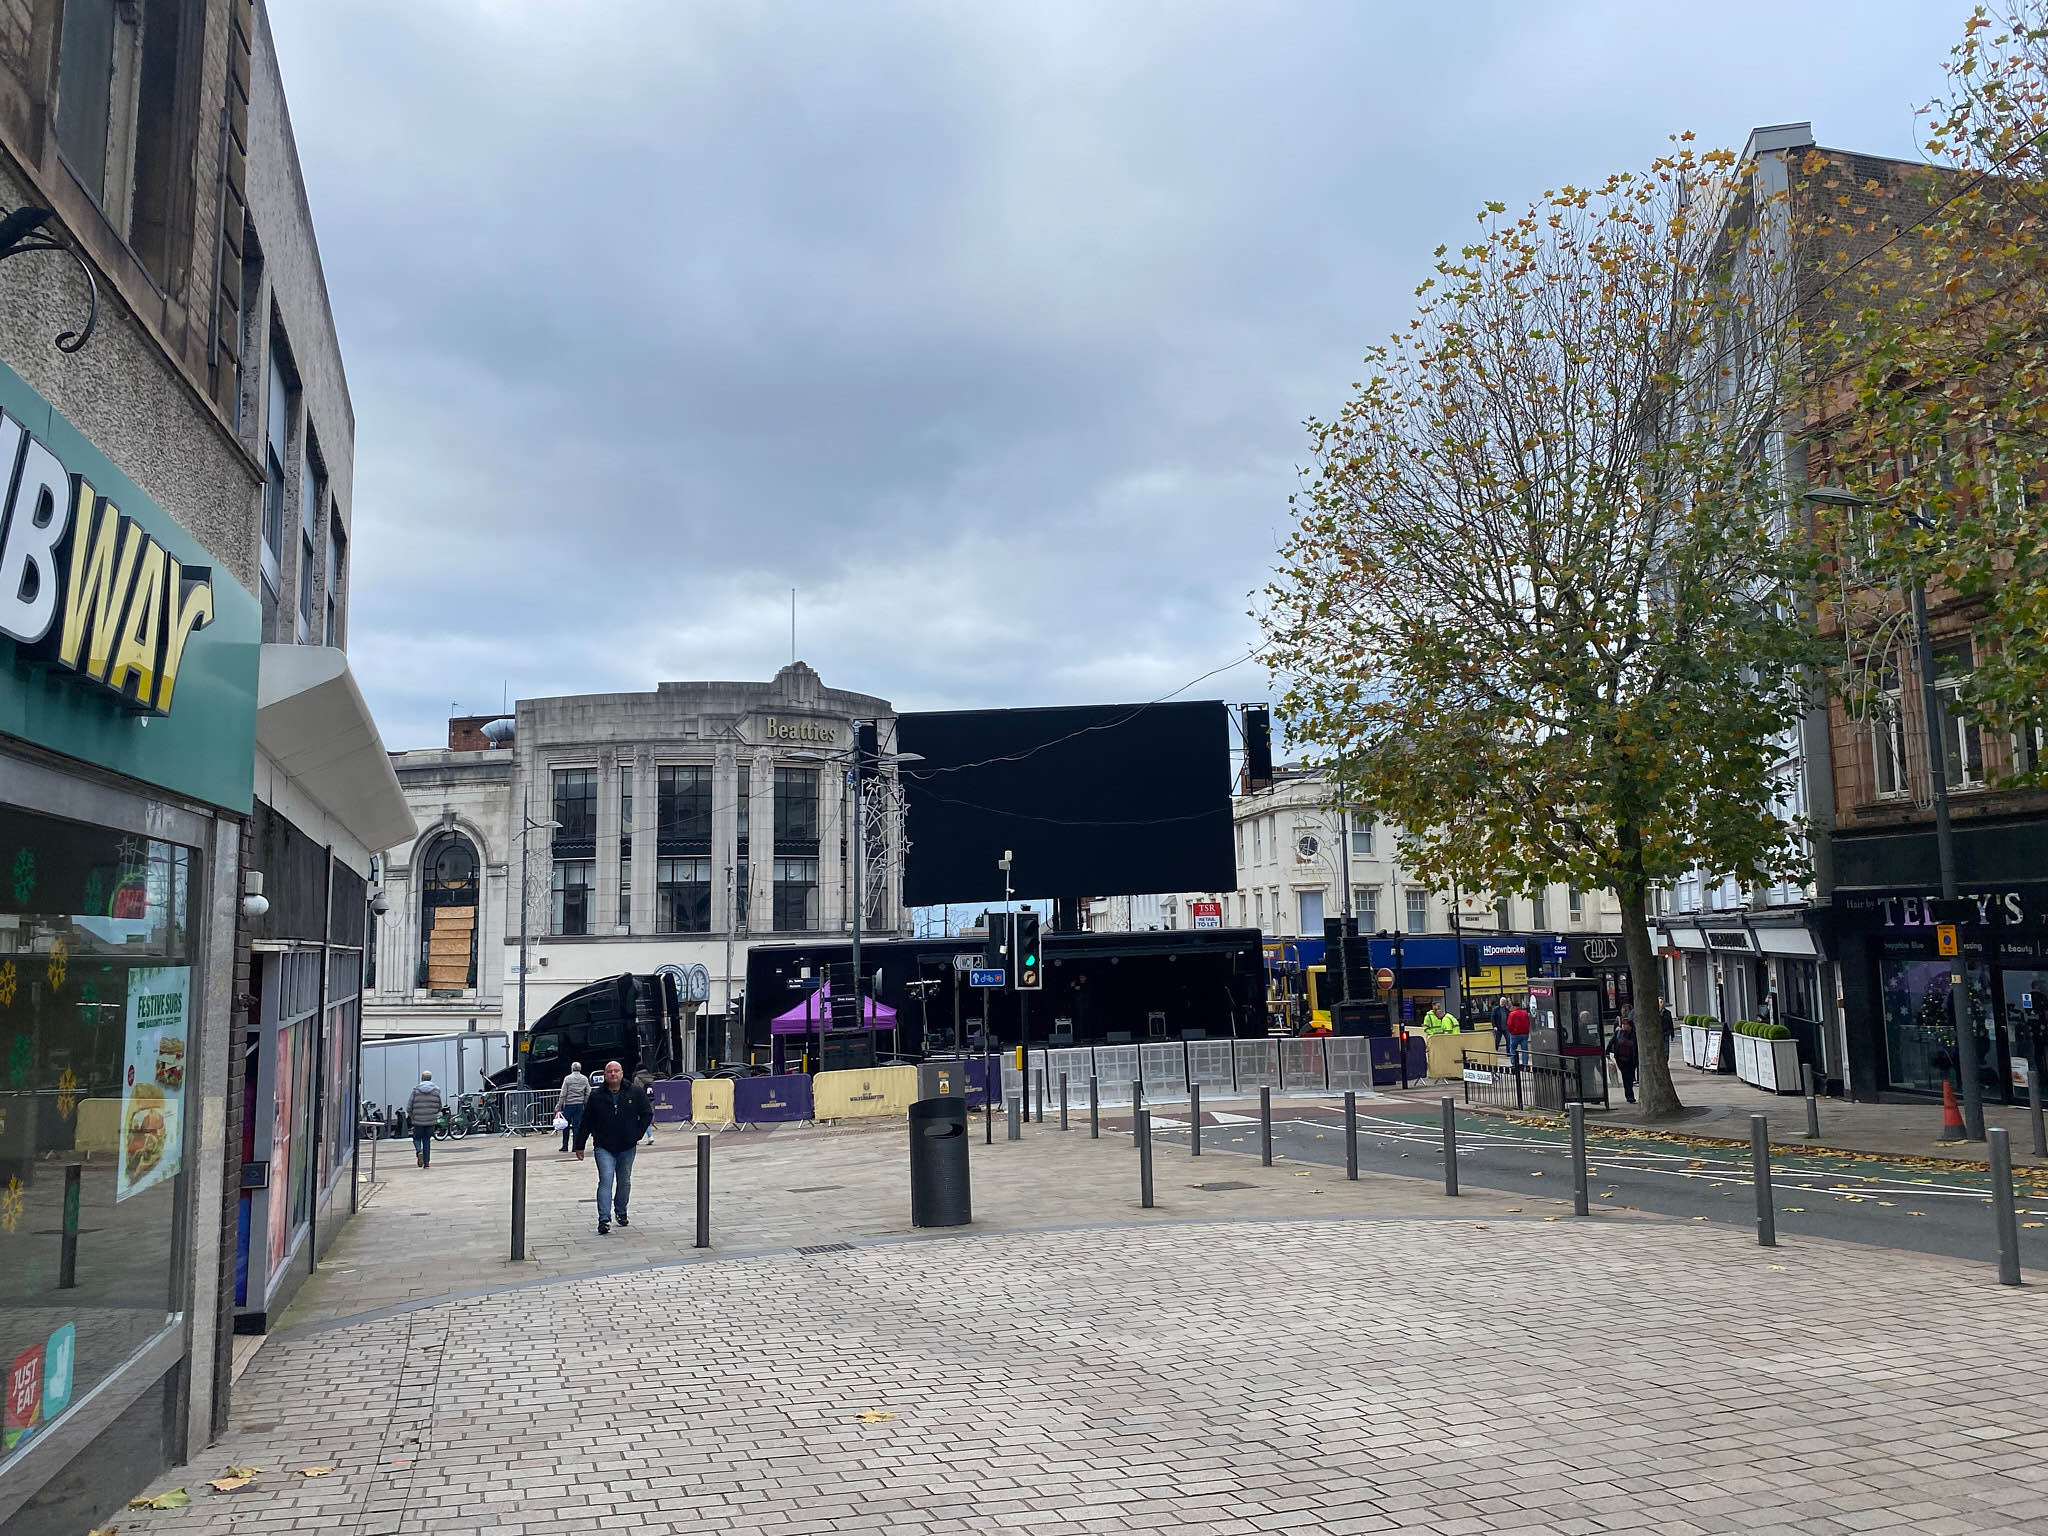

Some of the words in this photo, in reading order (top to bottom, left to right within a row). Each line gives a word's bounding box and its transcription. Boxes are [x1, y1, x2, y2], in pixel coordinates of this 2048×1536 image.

[766, 717, 837, 742] Beatties
[1199, 903, 1216, 912] TSR
[2008, 944, 2034, 953] Beauty
[137, 993, 165, 1018] FESTIVE
[12, 1357, 38, 1397] JUST
[16, 1381, 38, 1415] EAT
